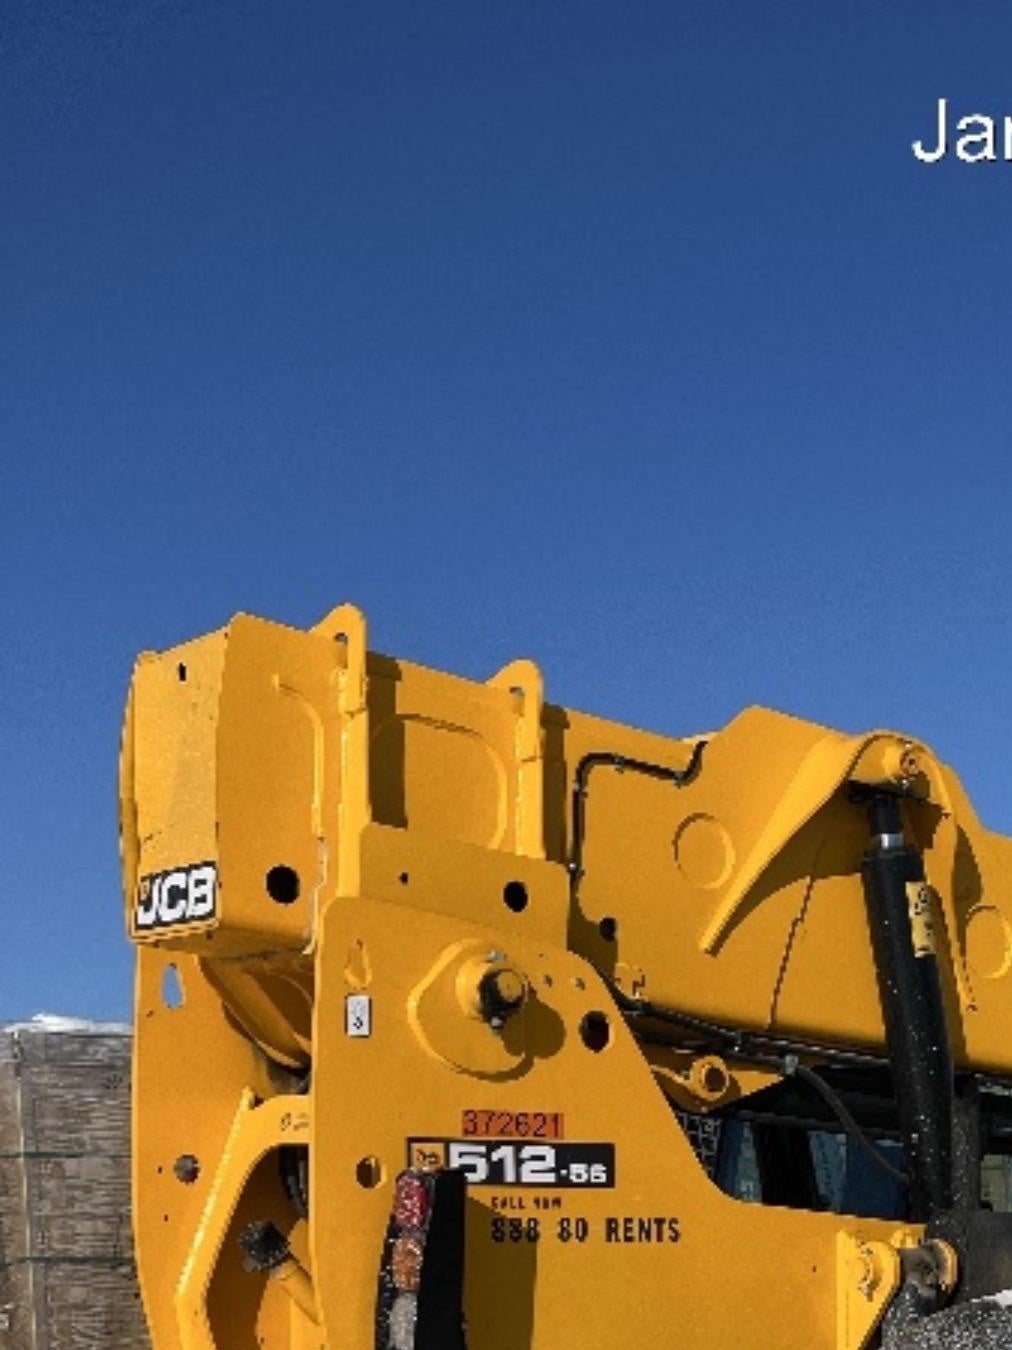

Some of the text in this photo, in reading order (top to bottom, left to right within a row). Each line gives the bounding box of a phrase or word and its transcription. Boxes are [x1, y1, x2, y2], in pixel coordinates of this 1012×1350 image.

[137, 866, 216, 925] JCB
[463, 1109, 562, 1138] 372621
[557, 1218, 589, 1243] 80
[605, 1218, 681, 1243] RENTS
